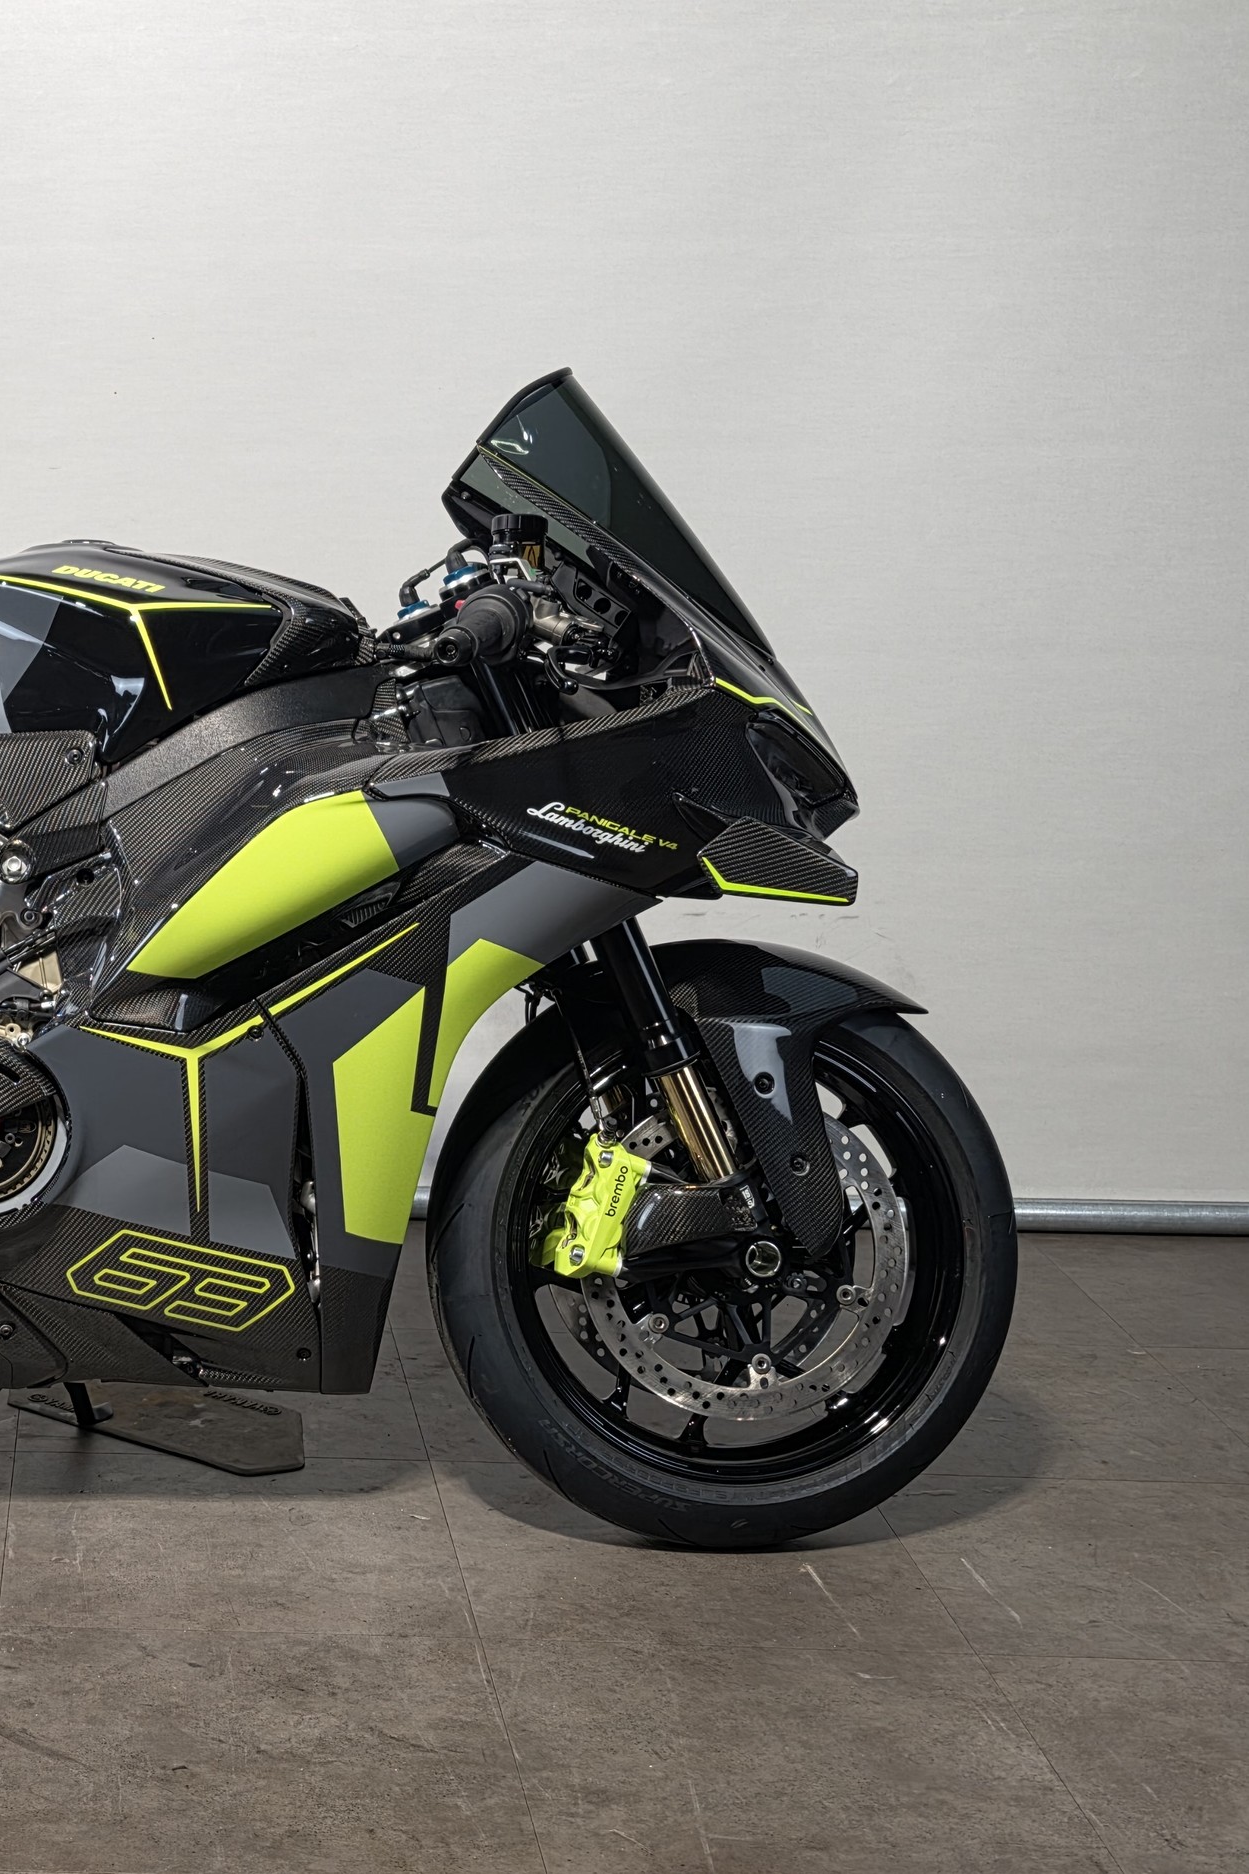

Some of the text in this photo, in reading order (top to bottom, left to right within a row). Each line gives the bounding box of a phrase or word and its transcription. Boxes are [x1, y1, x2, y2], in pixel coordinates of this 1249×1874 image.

[52, 565, 165, 593] DUCATI
[526, 801, 650, 853] Lamborghini
[565, 806, 678, 850] PANIGALE V4
[605, 1165, 629, 1217] brembo
[66, 1229, 296, 1332] 63
[537, 1419, 692, 1512] SUPERCORSA
